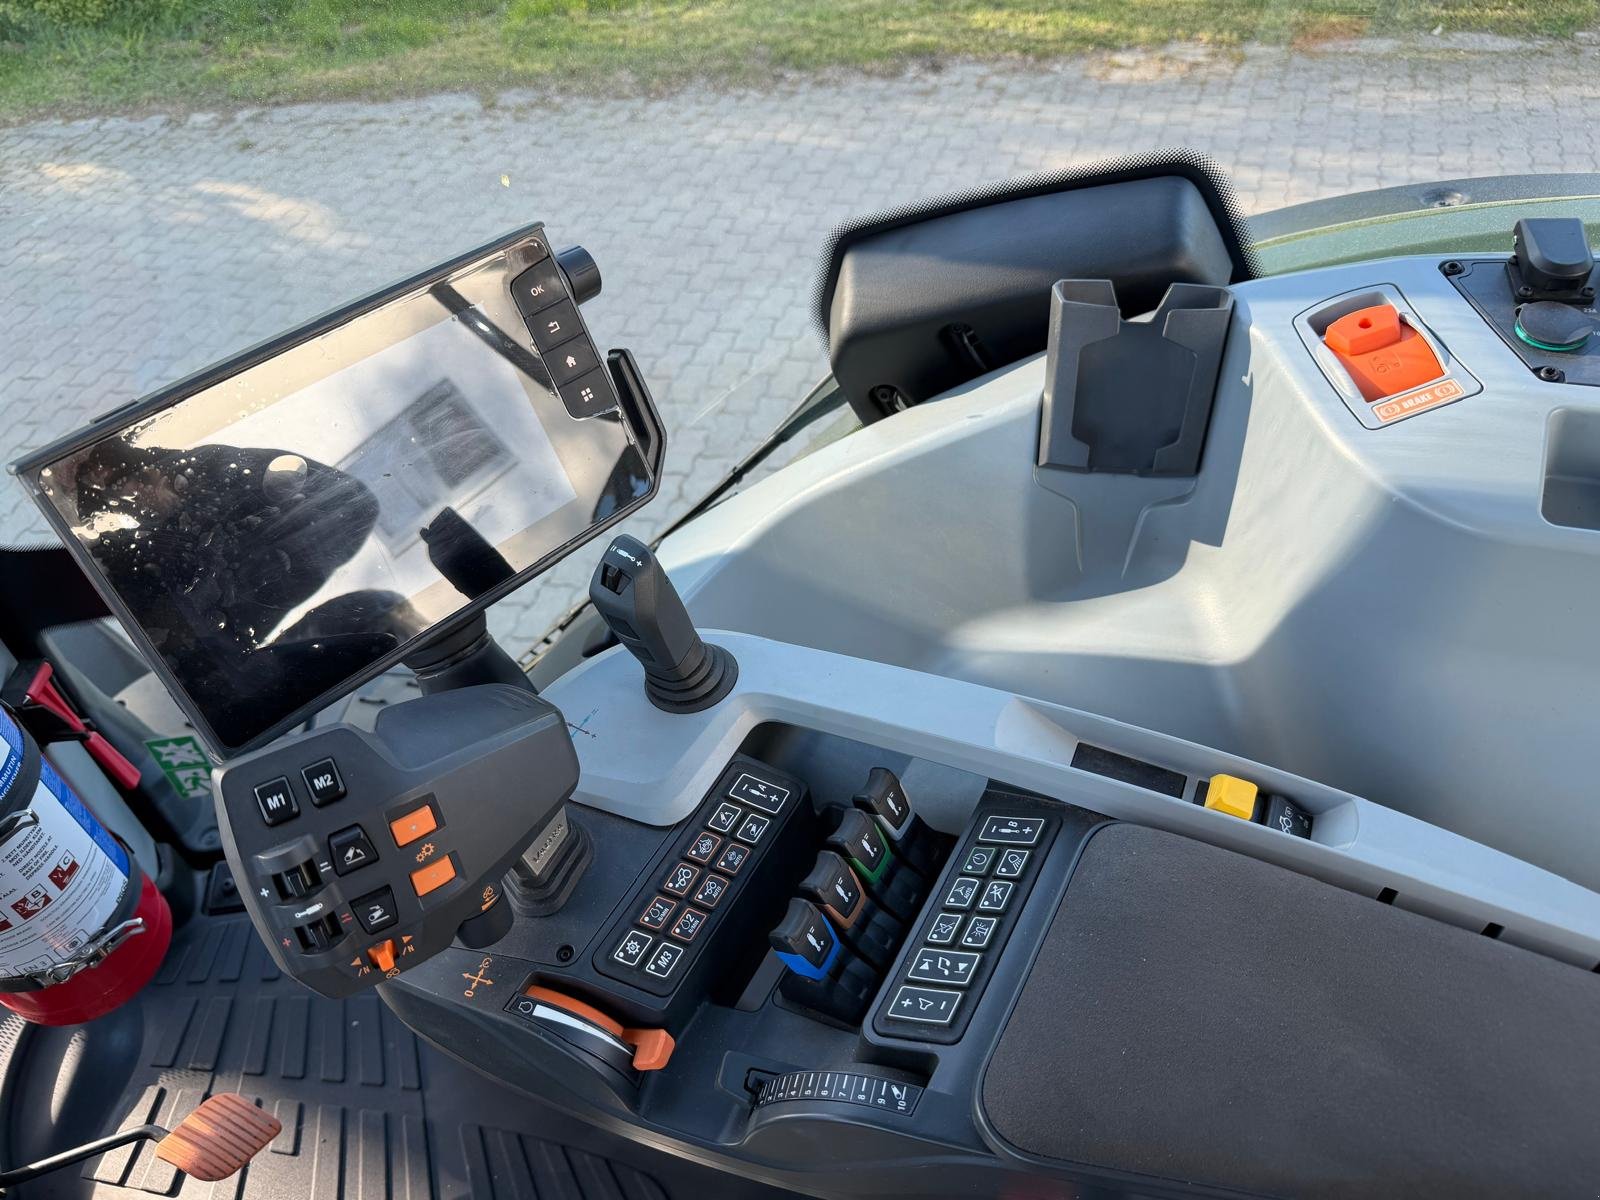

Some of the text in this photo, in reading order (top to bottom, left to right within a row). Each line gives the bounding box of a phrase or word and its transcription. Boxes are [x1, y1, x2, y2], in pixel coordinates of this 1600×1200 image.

[530, 284, 545, 297] OK
[1401, 392, 1434, 409] BRAKE
[313, 774, 334, 791] M2
[758, 783, 767, 792] A
[266, 792, 286, 811] M1
[1008, 820, 1018, 828] B
[62, 856, 71, 866] C
[733, 854, 743, 866] AUTO
[31, 889, 41, 899] B
[712, 885, 722, 898] AUTO
[963, 886, 973, 899] AUTO
[686, 913, 695, 922] 2
[657, 951, 673, 968] M3
[897, 1100, 907, 1111] 10
